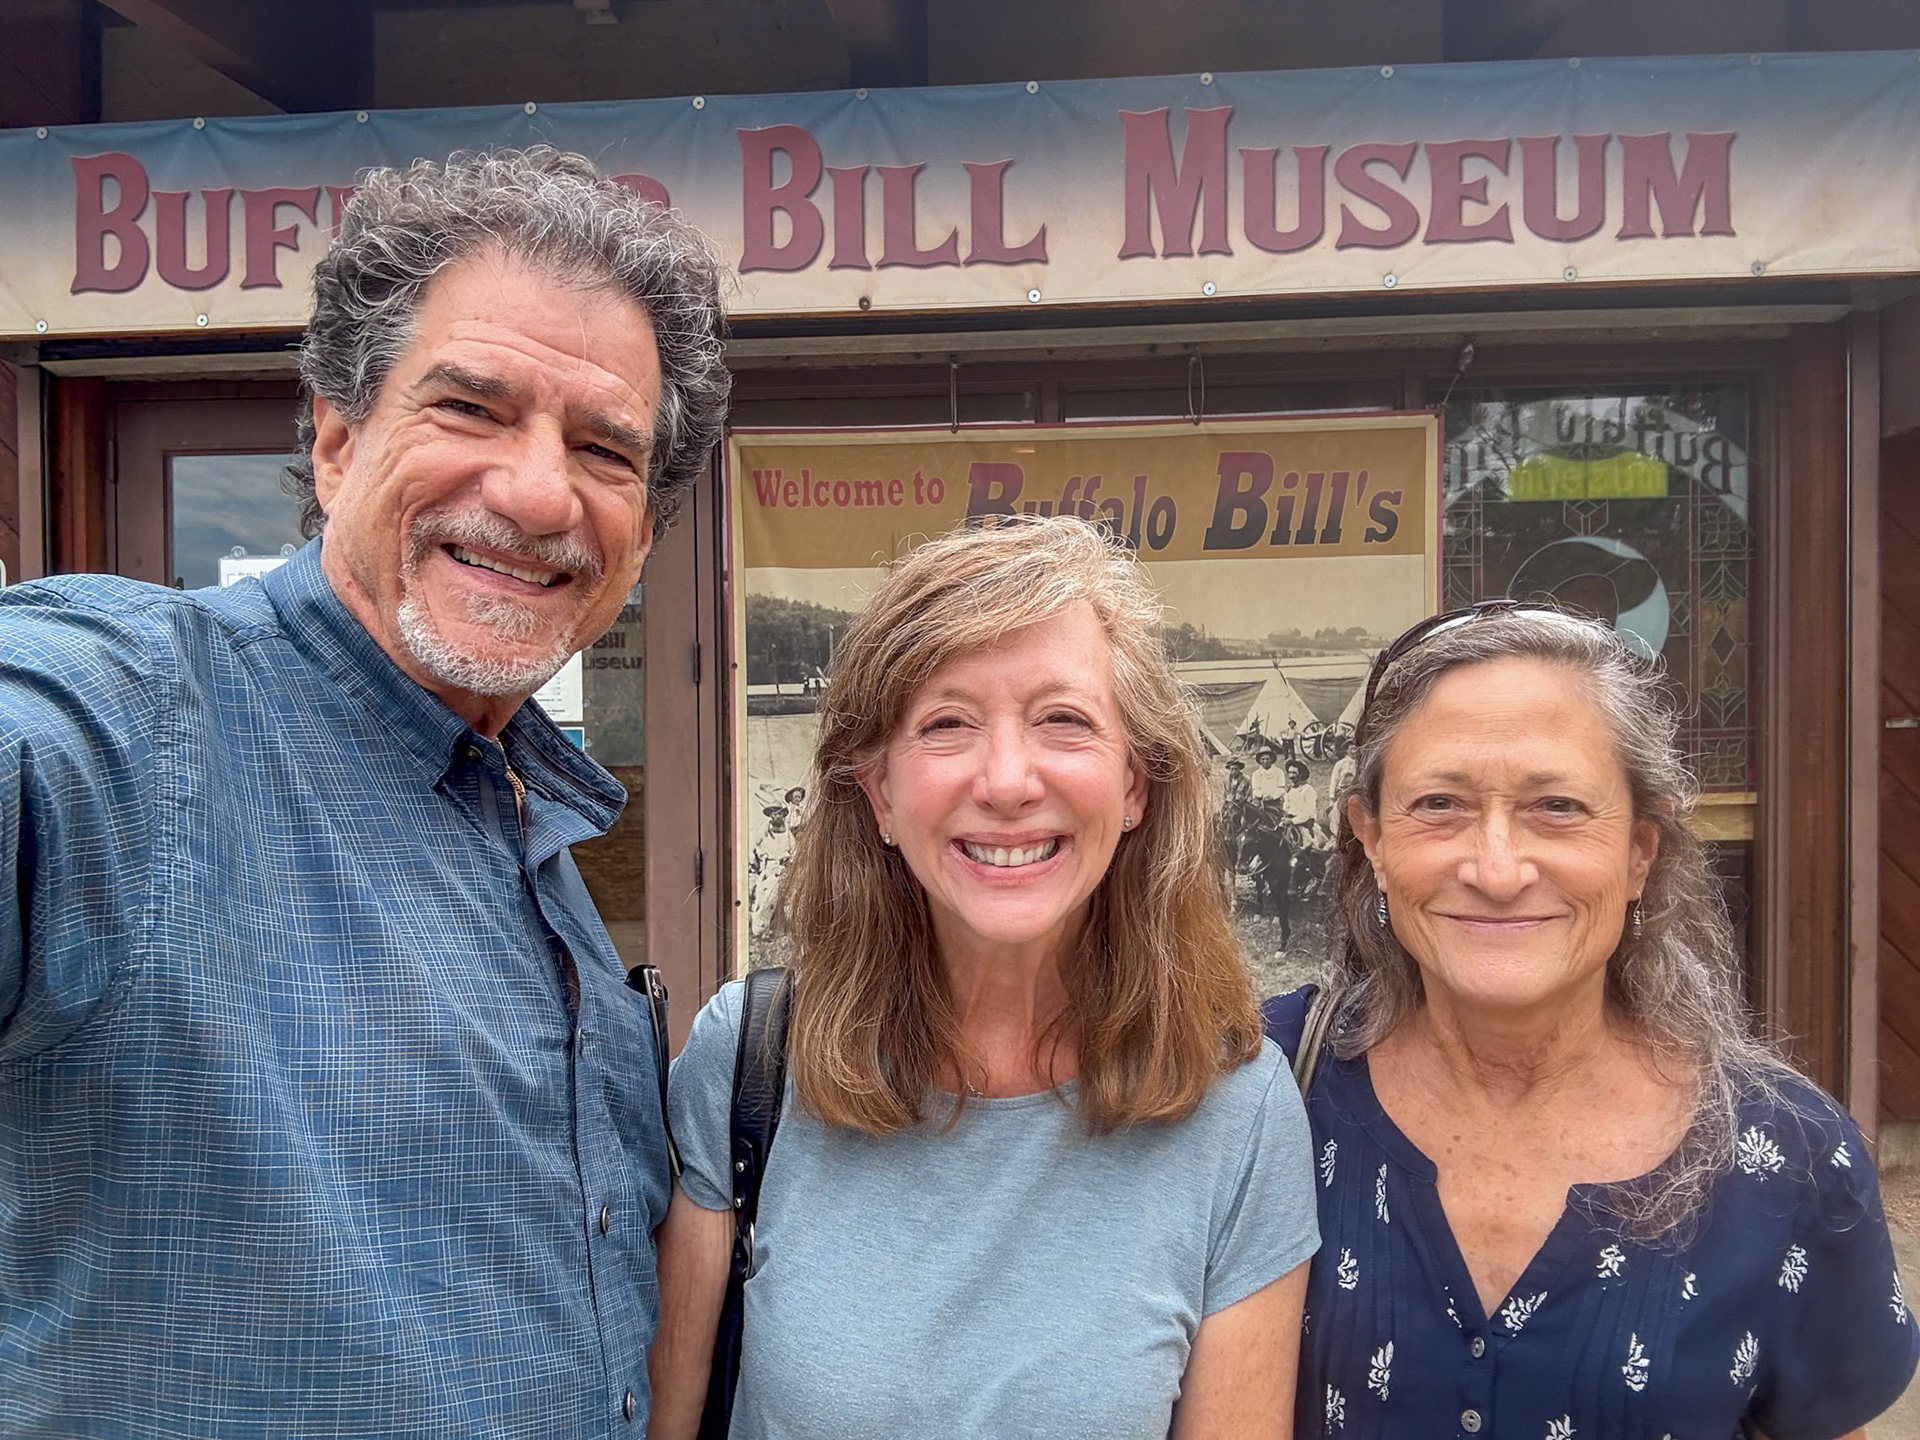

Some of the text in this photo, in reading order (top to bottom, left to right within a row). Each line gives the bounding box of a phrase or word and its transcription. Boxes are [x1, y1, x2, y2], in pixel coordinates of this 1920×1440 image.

[736, 123, 1049, 275] BILL
[1117, 105, 1738, 261] MUSEUM
[752, 469, 904, 508] Welcome
[912, 468, 946, 506] to
[1202, 451, 1403, 550] Bill's
